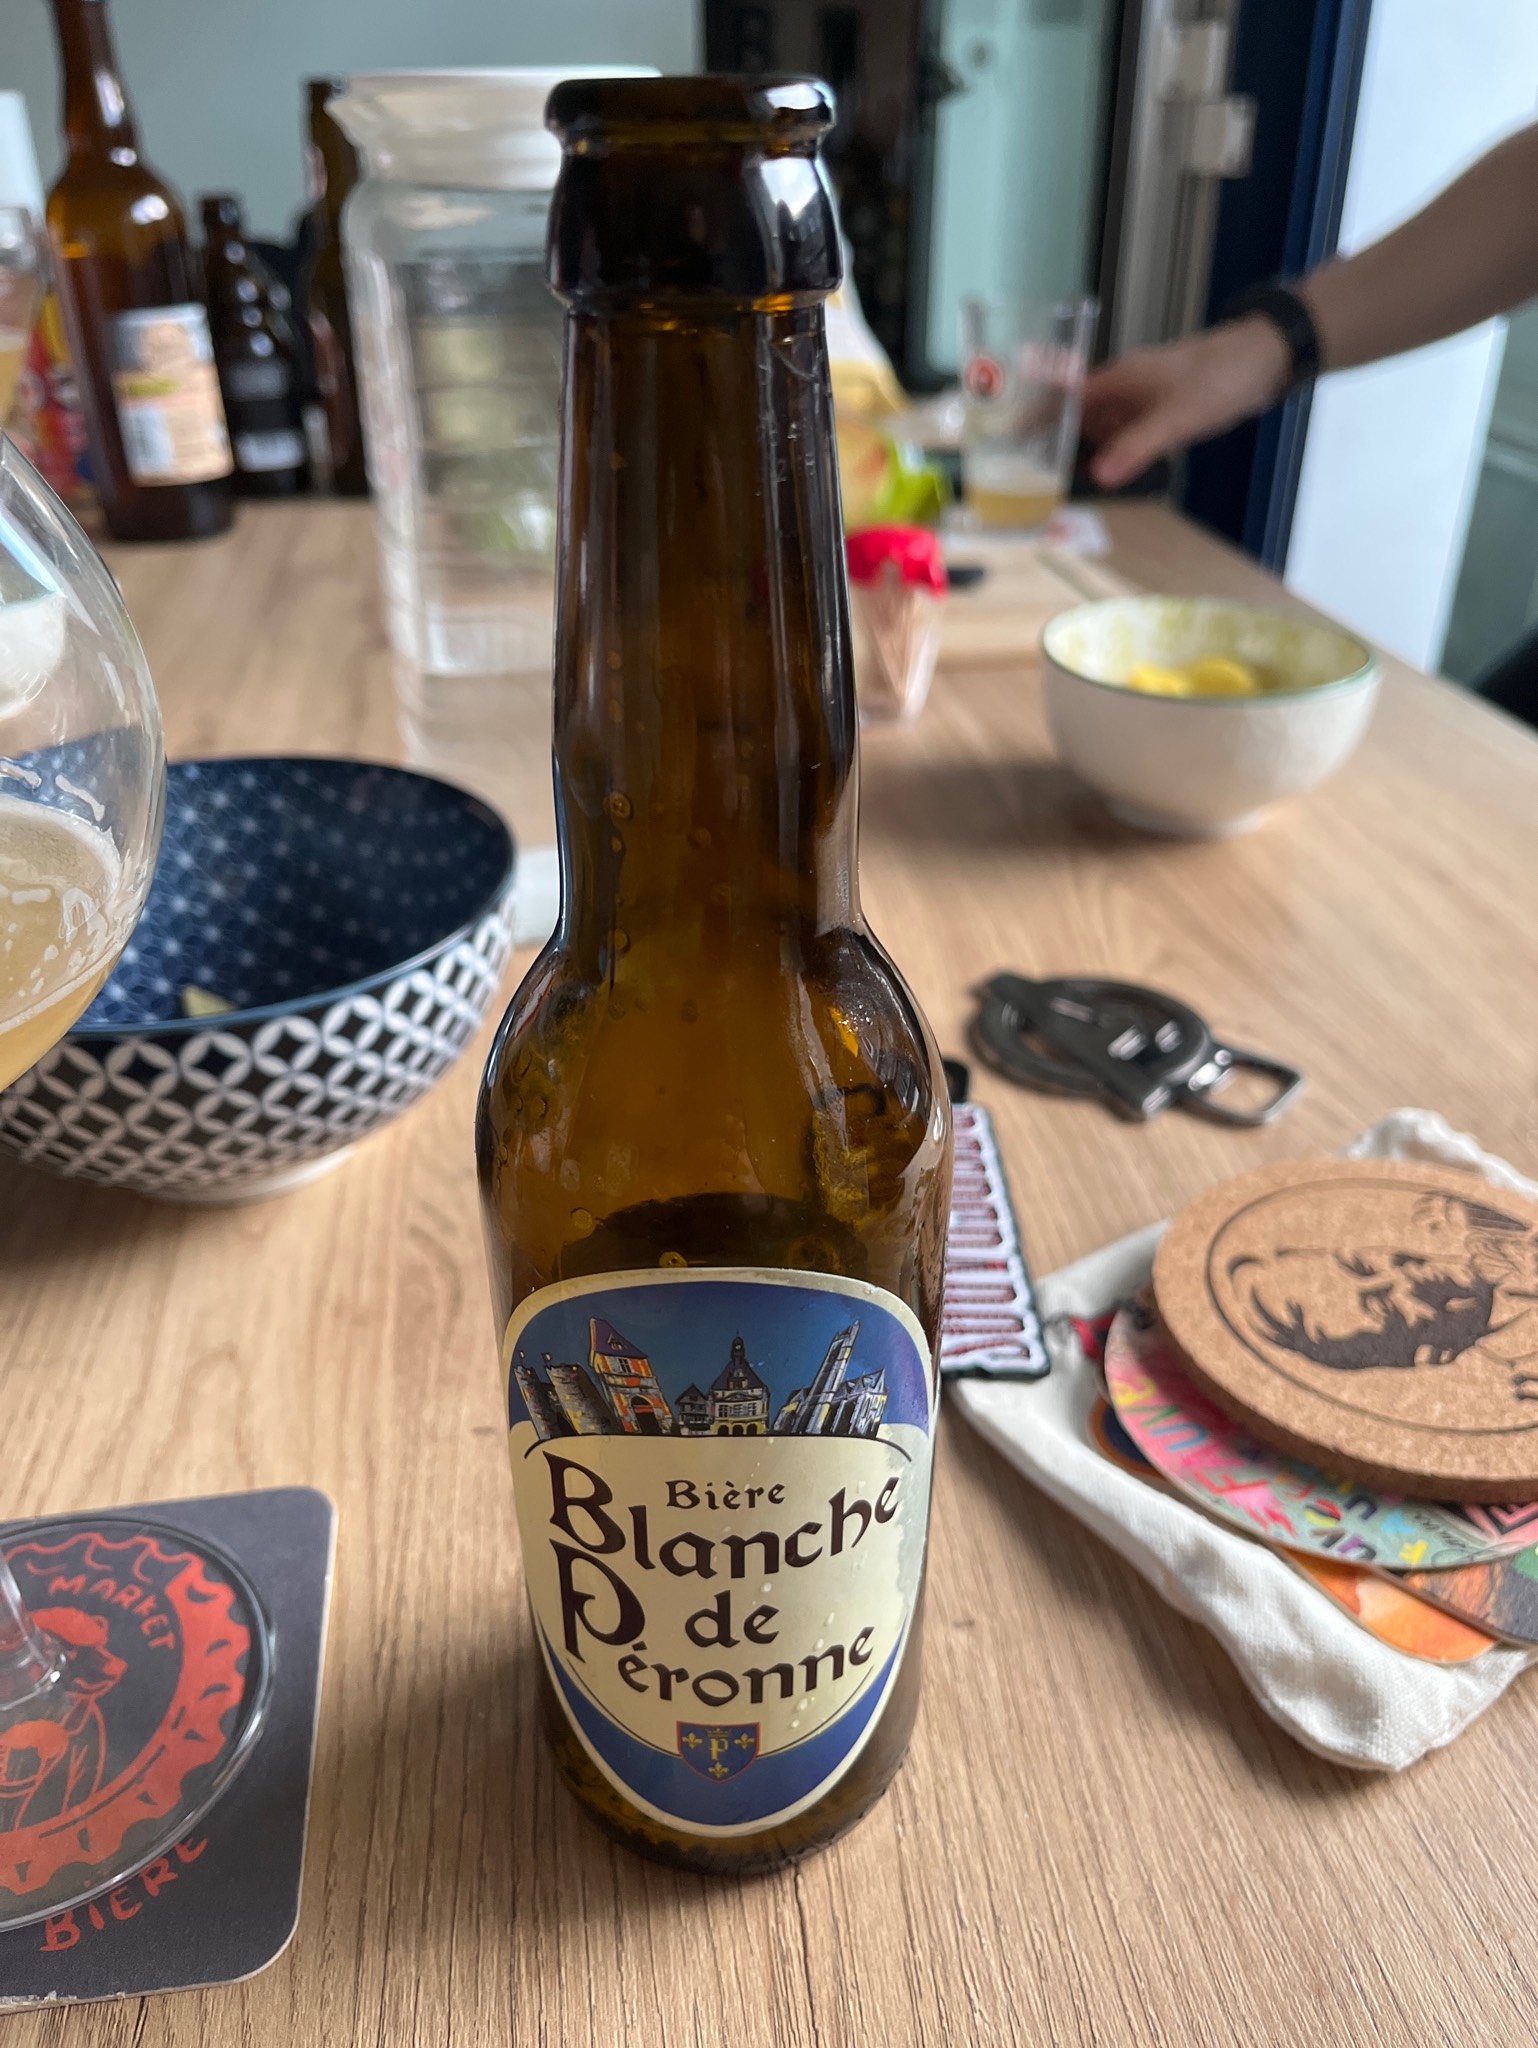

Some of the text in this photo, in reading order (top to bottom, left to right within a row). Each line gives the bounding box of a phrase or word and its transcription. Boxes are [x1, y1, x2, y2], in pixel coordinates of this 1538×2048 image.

[542, 1450, 900, 1580] Blanche
[665, 1479, 786, 1511] Bière
[48, 1573, 176, 1650] MARKET
[548, 1538, 876, 1707] Péronne
[684, 1590, 781, 1649] de
